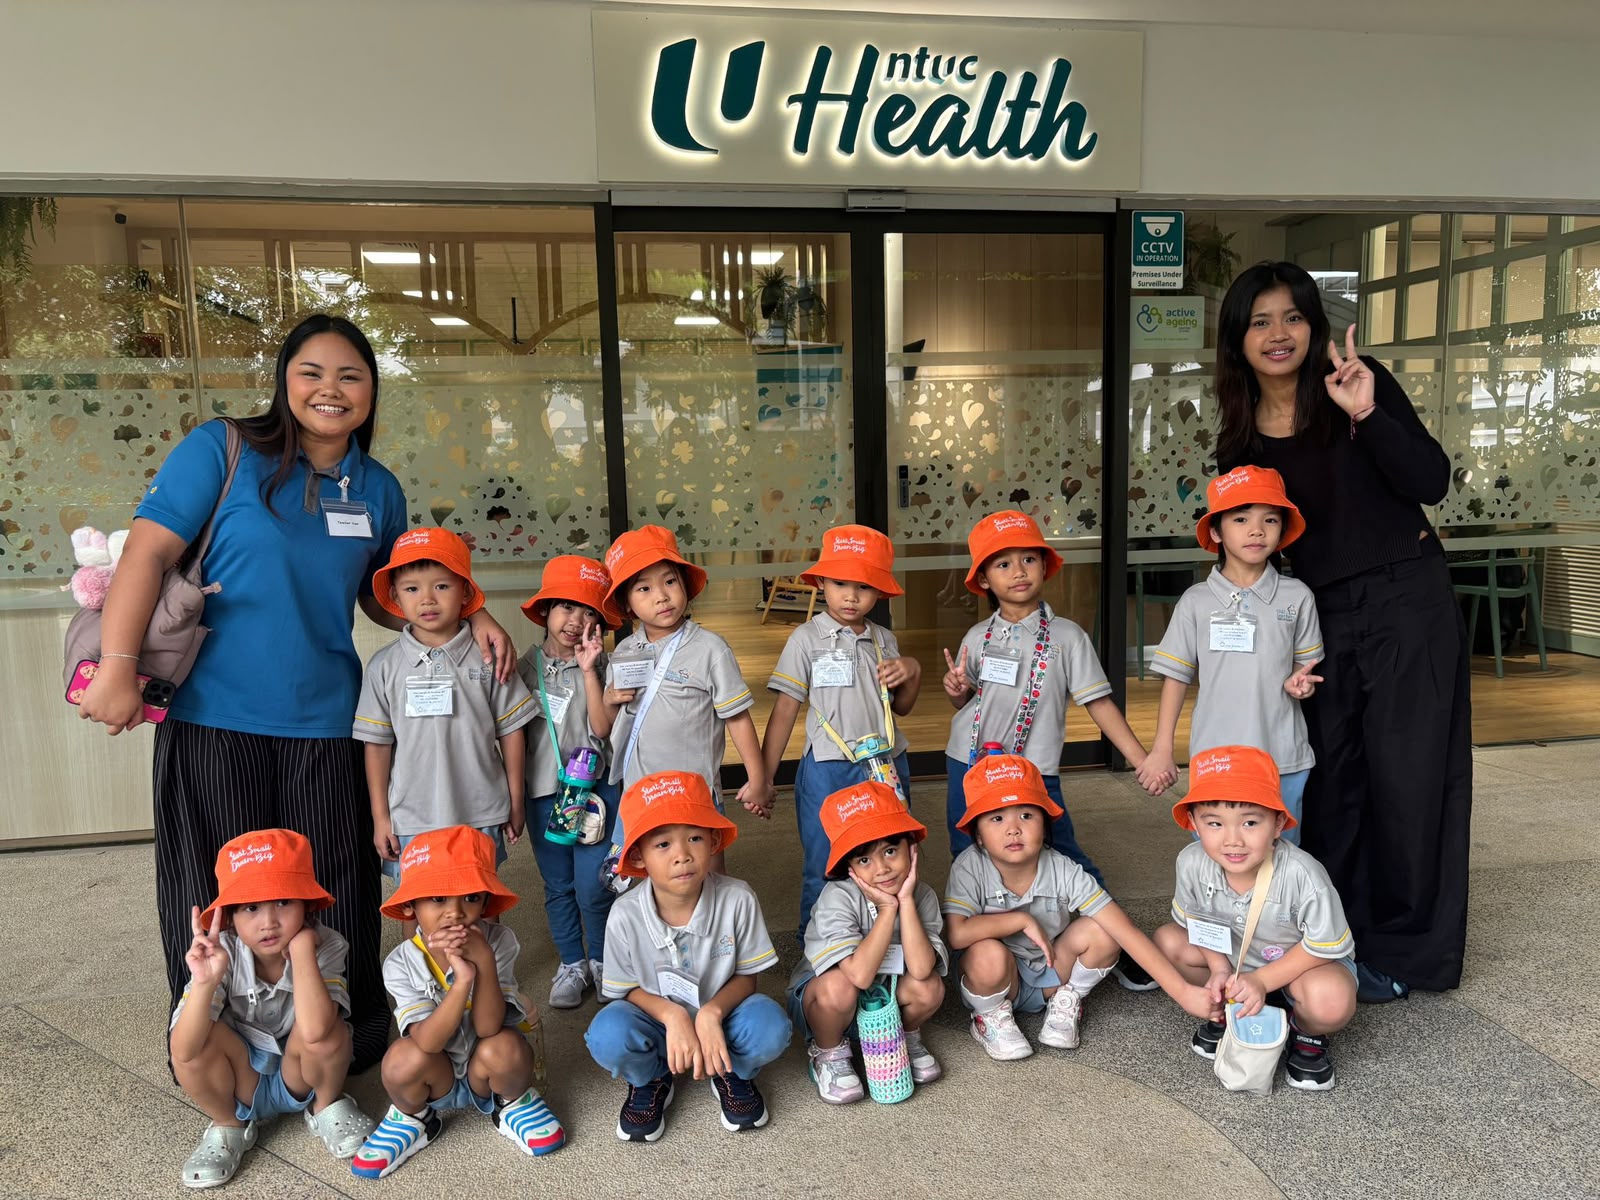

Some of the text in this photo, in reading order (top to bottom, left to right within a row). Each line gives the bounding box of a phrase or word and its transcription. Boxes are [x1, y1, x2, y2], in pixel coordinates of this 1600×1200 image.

[886, 46, 979, 82] ntuc
[786, 44, 1099, 161] Health
[1141, 242, 1174, 253] CCTV
[1166, 308, 1196, 317] active
[1166, 317, 1197, 328] ageing
[1229, 470, 1248, 479] Small
[1235, 475, 1250, 484] Big
[834, 542, 853, 553] Dream
[641, 777, 682, 796] Start Small
[985, 774, 1010, 784] Dream
[642, 786, 686, 806] Dream Big
[837, 793, 870, 813] Start Small
[838, 800, 875, 823] Dream Big
[229, 843, 272, 861] Start Small
[416, 853, 431, 865] Big
[231, 851, 274, 873] Dream Big
